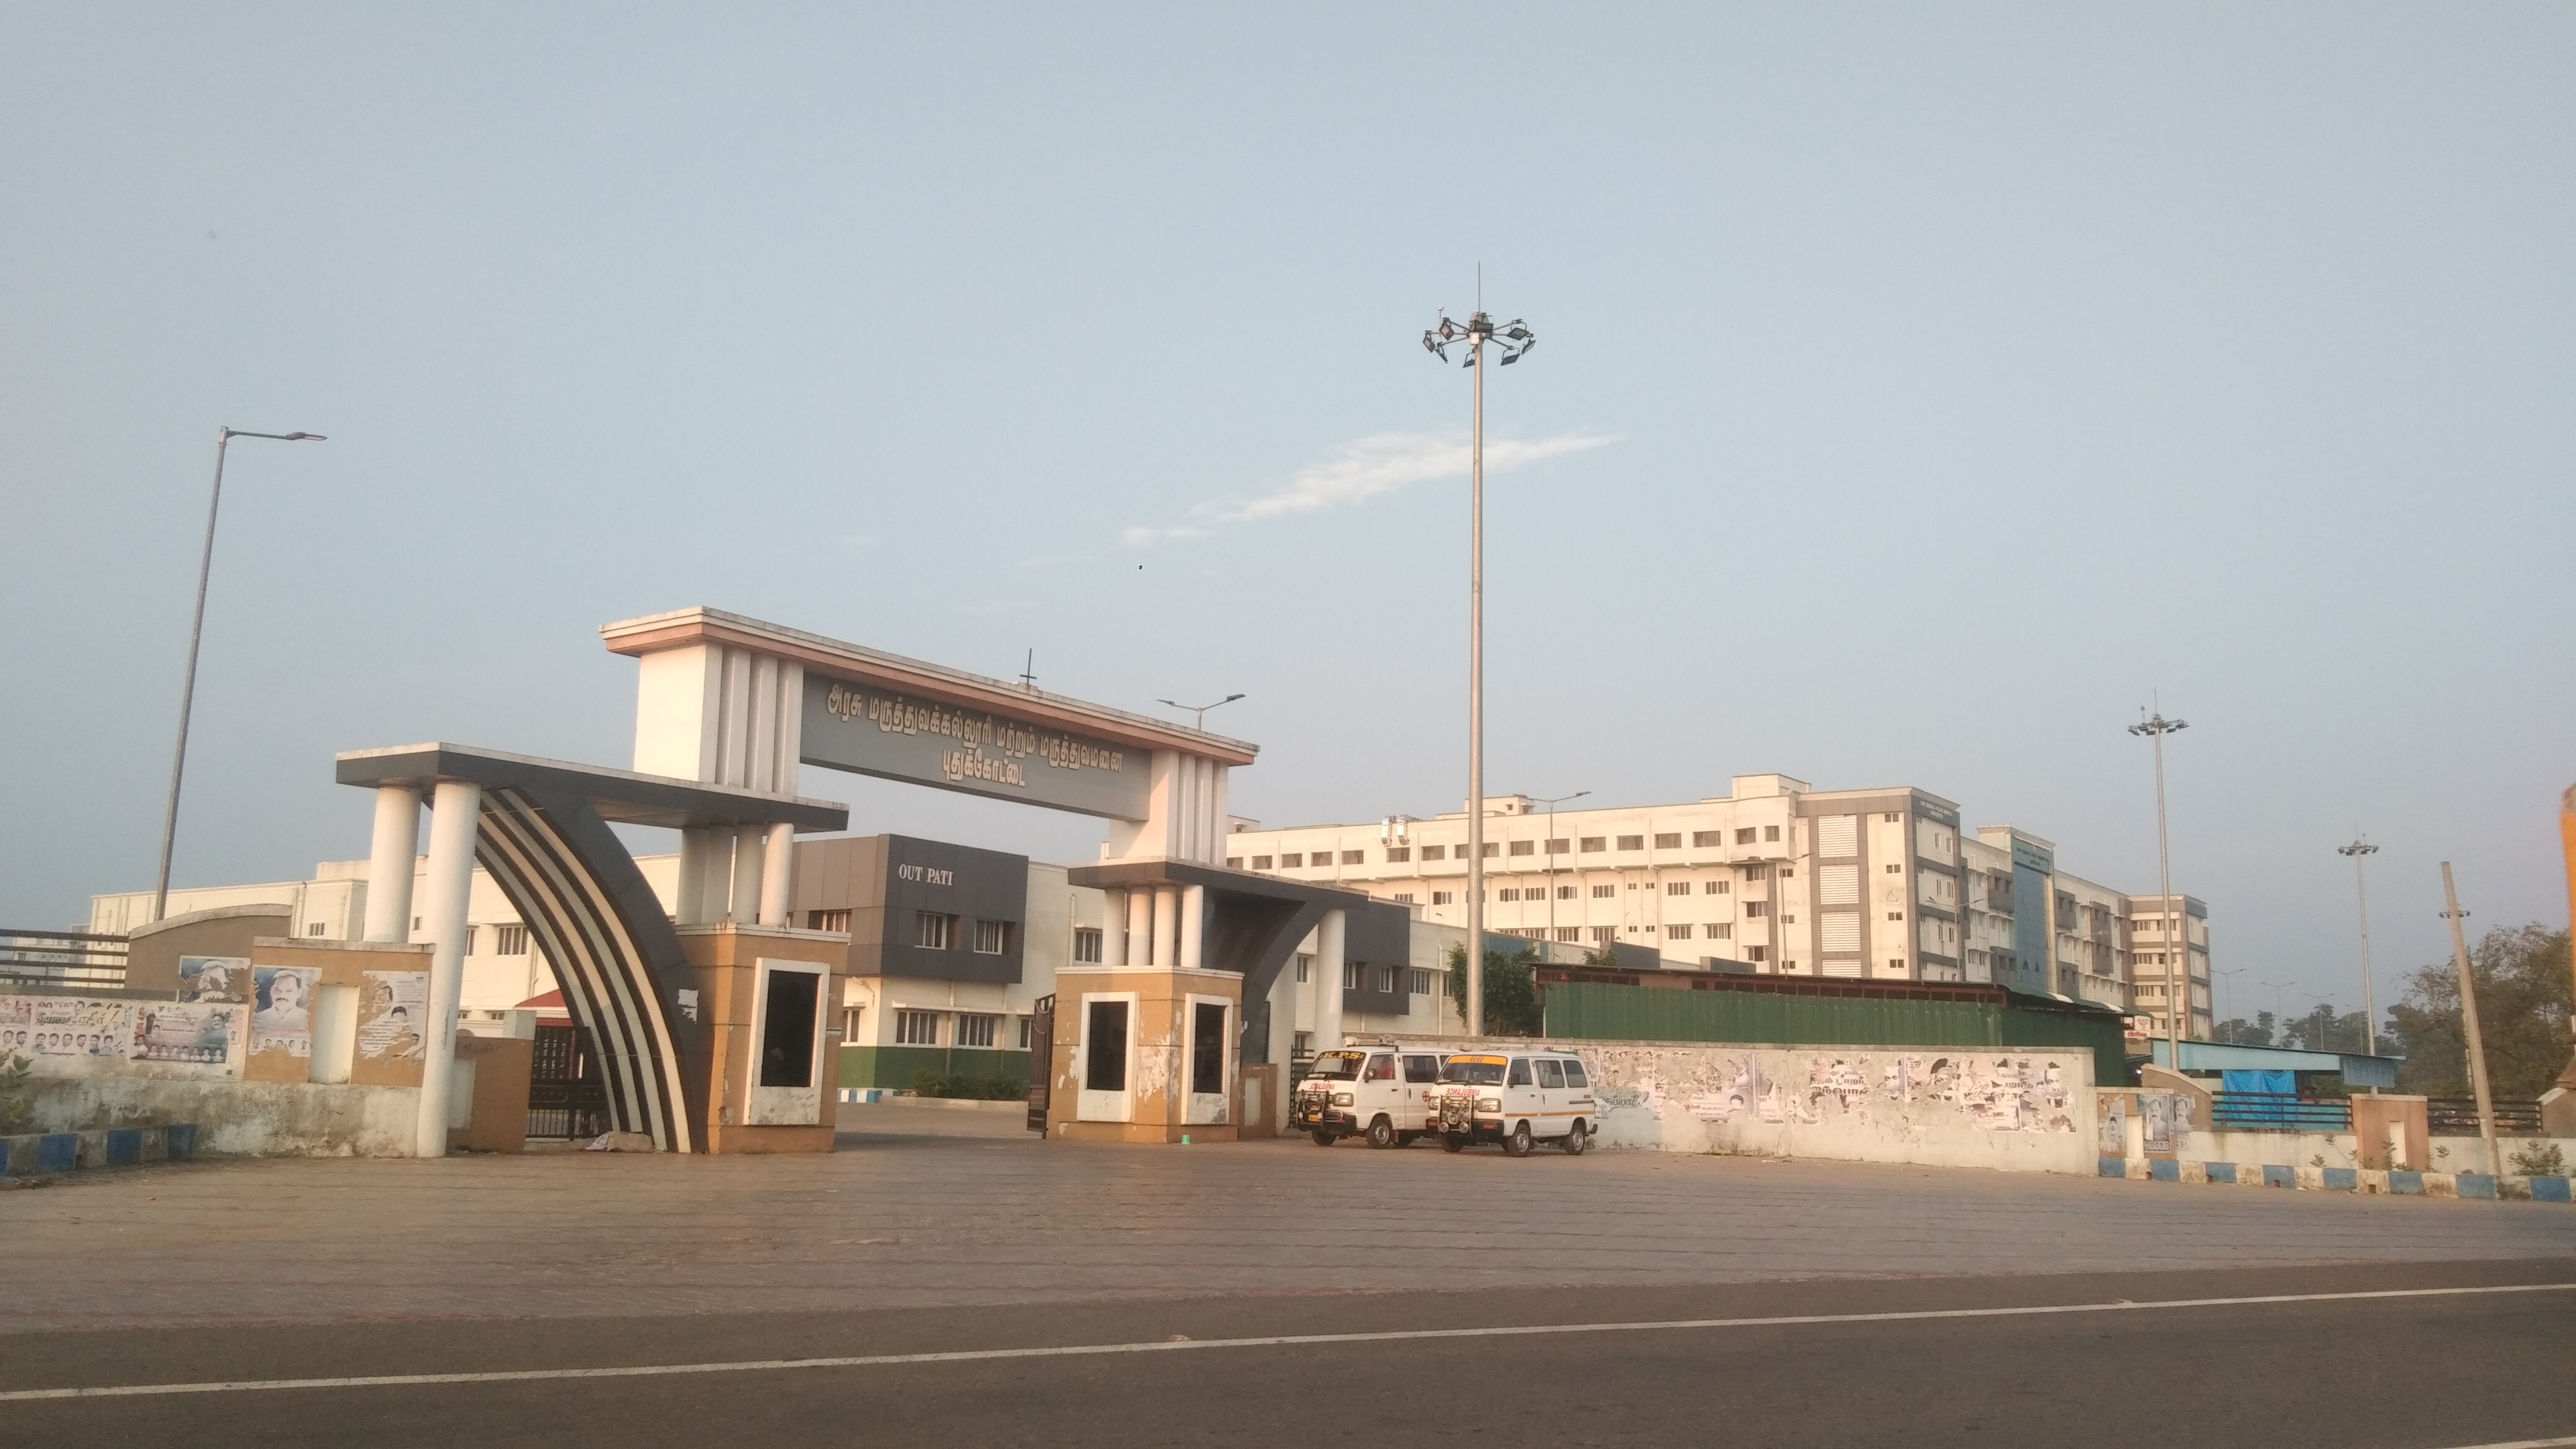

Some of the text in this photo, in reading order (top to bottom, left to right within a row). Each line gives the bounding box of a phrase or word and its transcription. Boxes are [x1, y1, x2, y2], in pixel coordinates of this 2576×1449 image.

[827, 684, 1123, 772] அரசு மருத்துவக்கல்லூரி மற்றும் மருத்துவமனை
[942, 748, 1025, 786] புதுக்கோட்டை
[899, 864, 954, 886] OUT PATI
